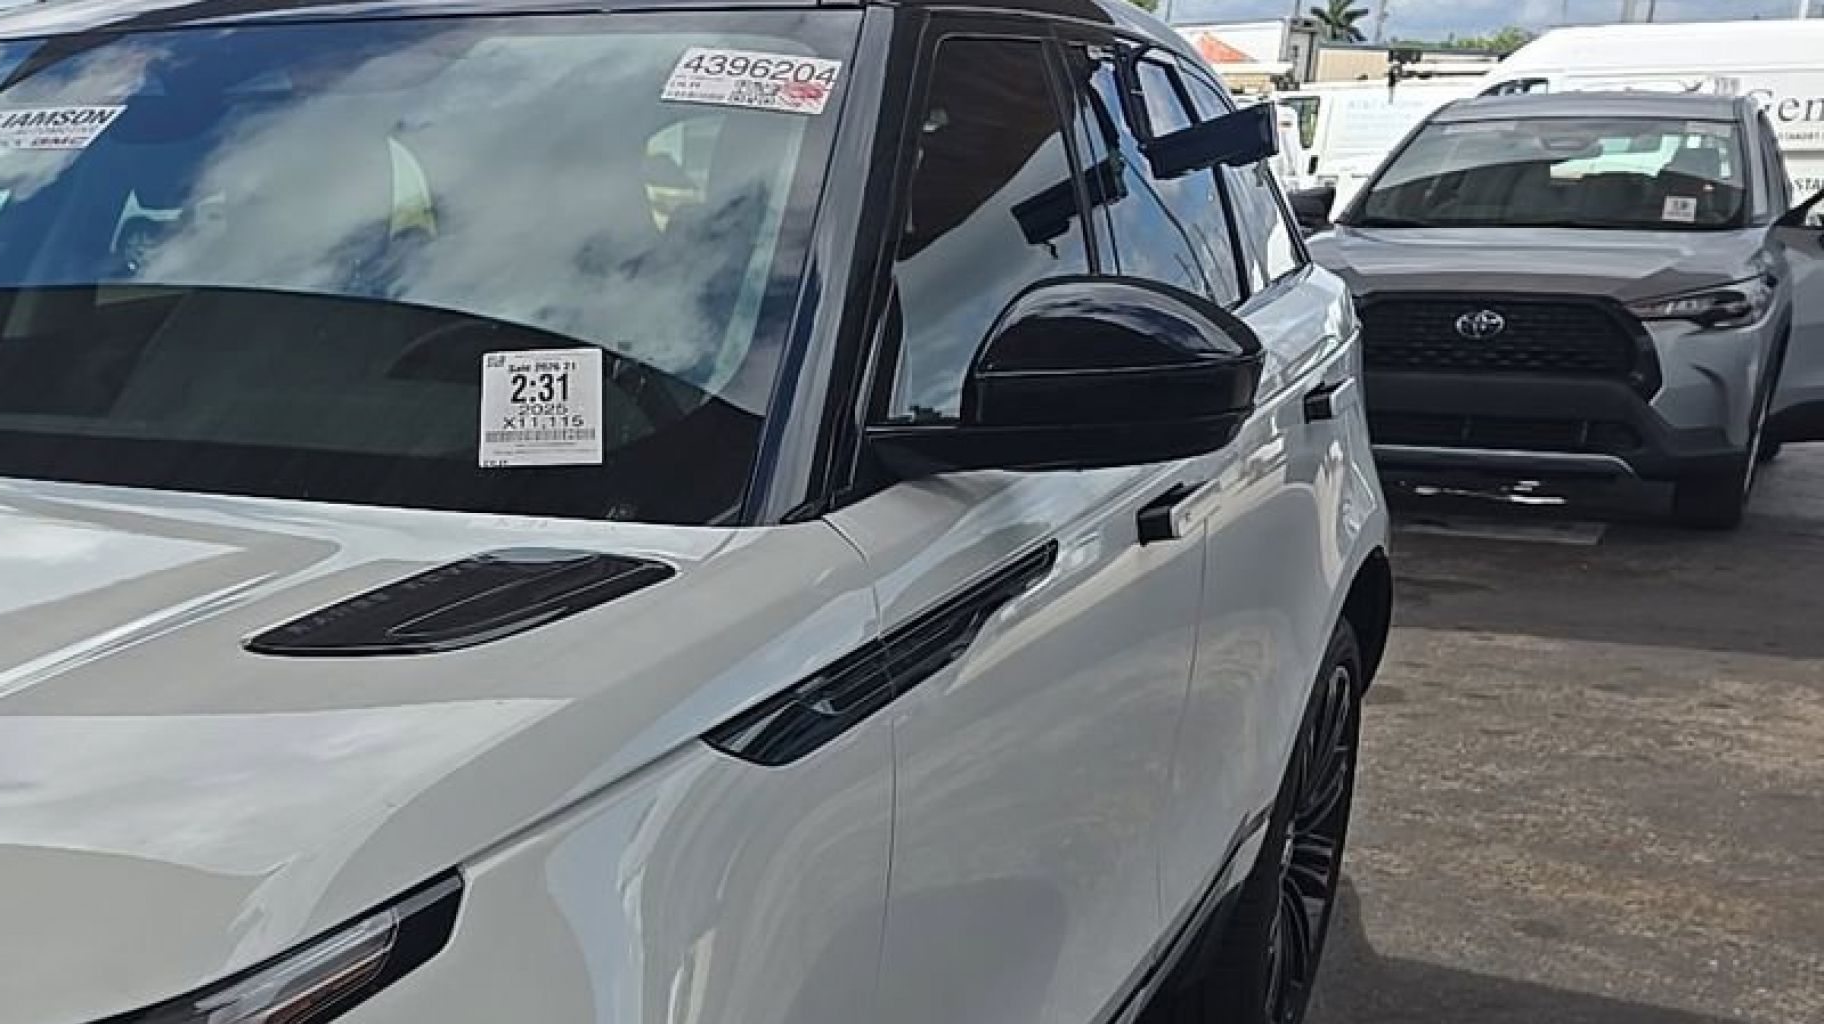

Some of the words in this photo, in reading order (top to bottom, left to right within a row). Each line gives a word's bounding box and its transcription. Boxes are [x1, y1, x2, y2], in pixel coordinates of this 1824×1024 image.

[683, 54, 837, 85] 4396204
[510, 373, 568, 404] 2:31
[519, 404, 569, 416] 2025
